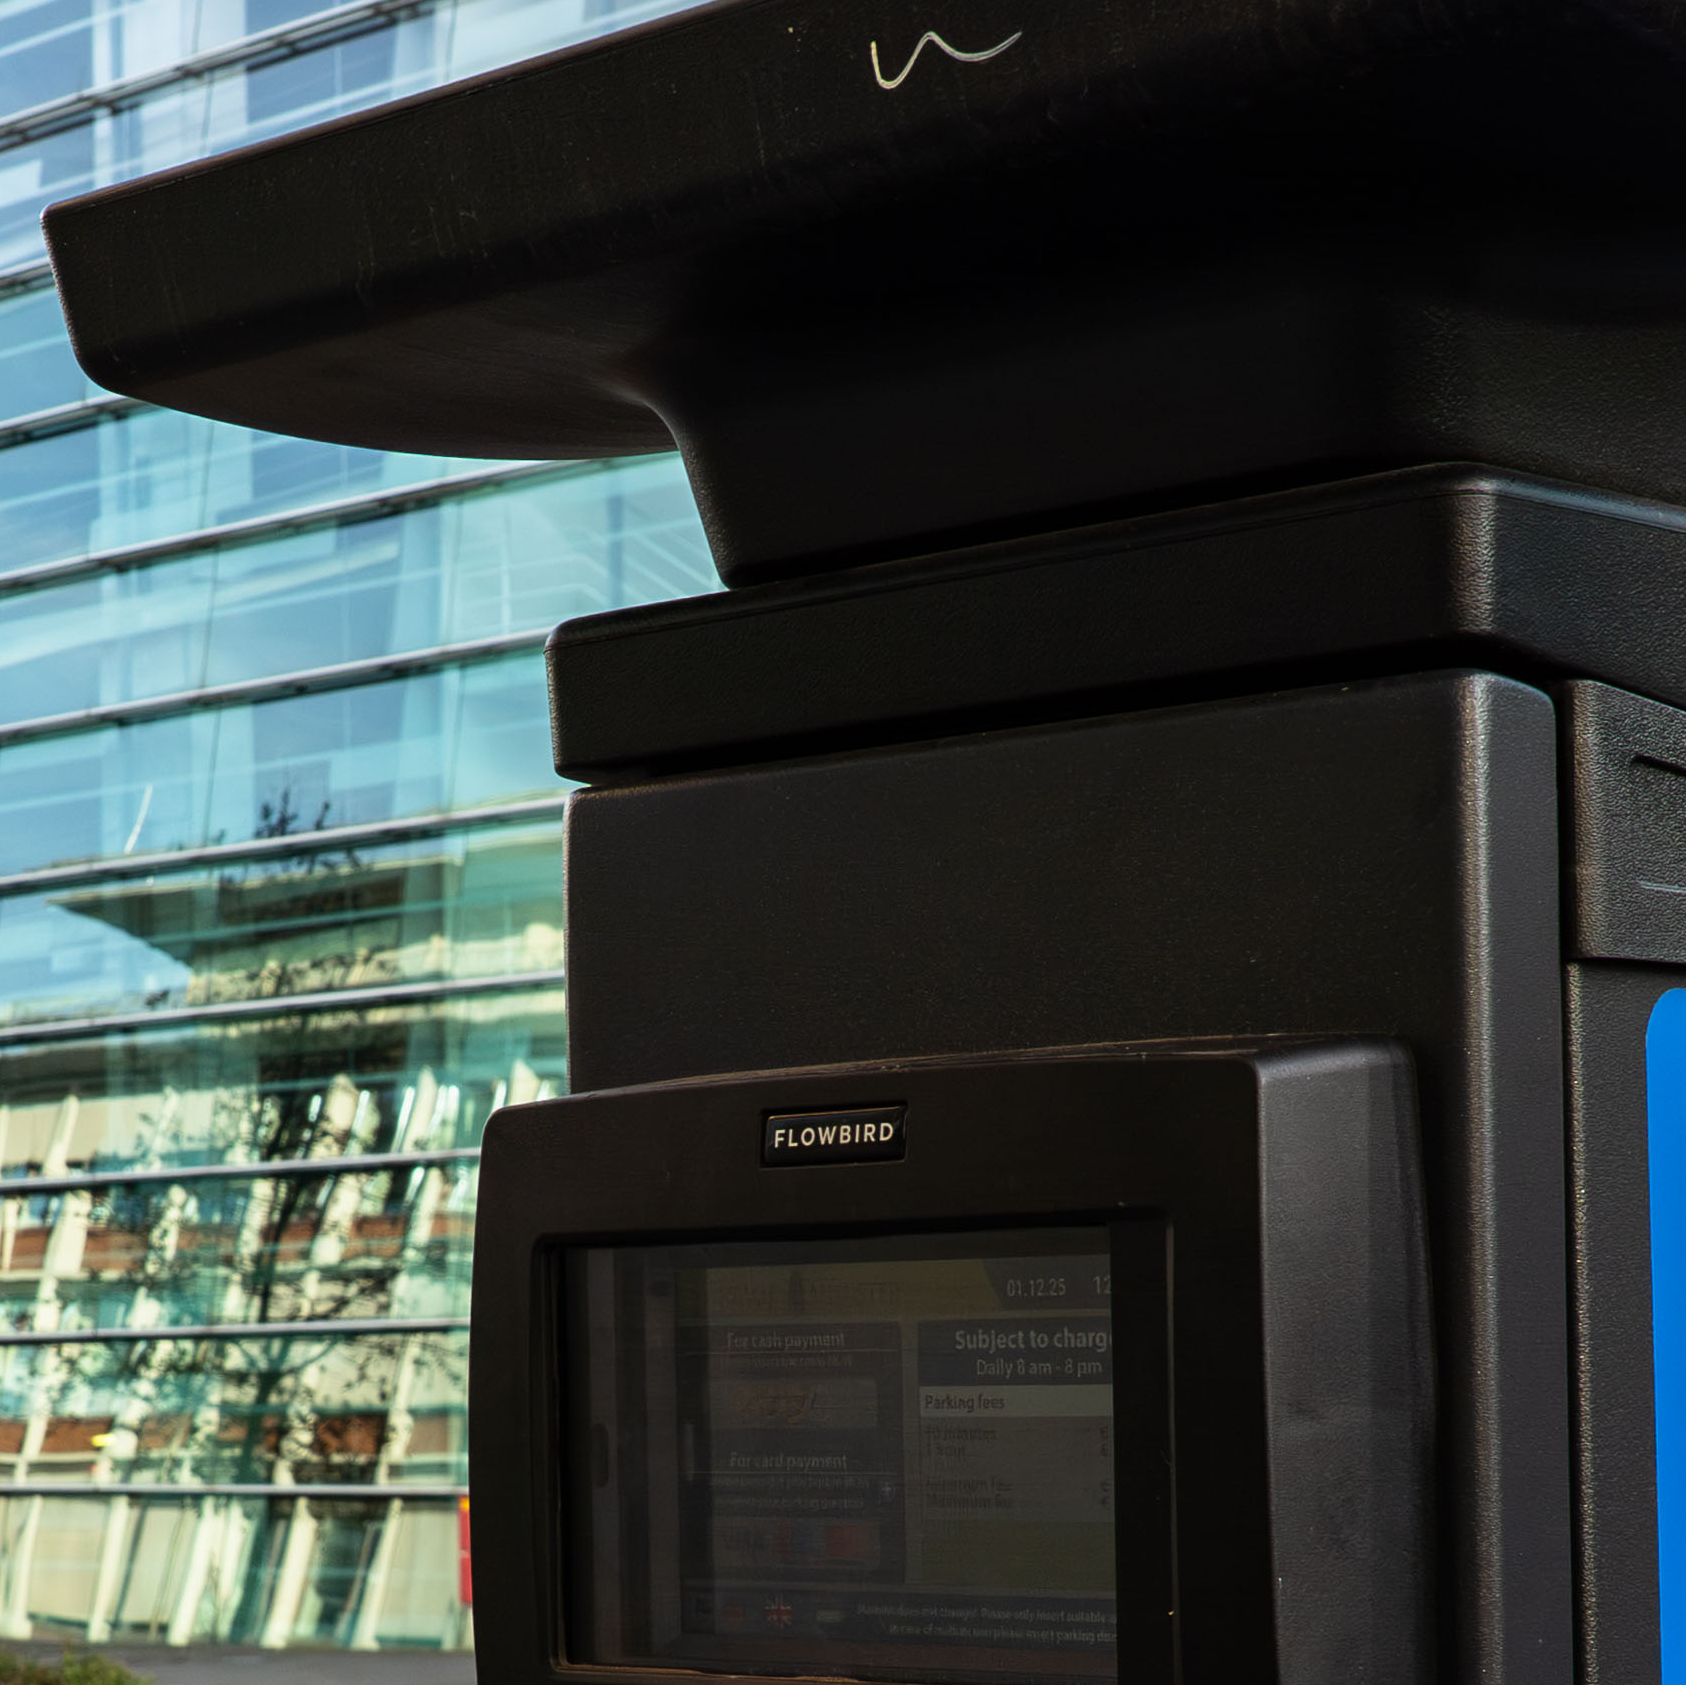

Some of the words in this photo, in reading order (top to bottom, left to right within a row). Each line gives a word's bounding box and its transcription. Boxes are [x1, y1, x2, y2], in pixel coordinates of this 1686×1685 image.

[774, 1122, 894, 1148] FLOWBIRD
[955, 1329, 1025, 1354] Subject
[1029, 1330, 1049, 1348] to
[1053, 1327, 1112, 1353] charg
[976, 1358, 1013, 1378] Daily
[1029, 1363, 1052, 1375] am
[1077, 1361, 1103, 1378] pm
[924, 1394, 974, 1413] Parking
[978, 1393, 1005, 1409] fees
